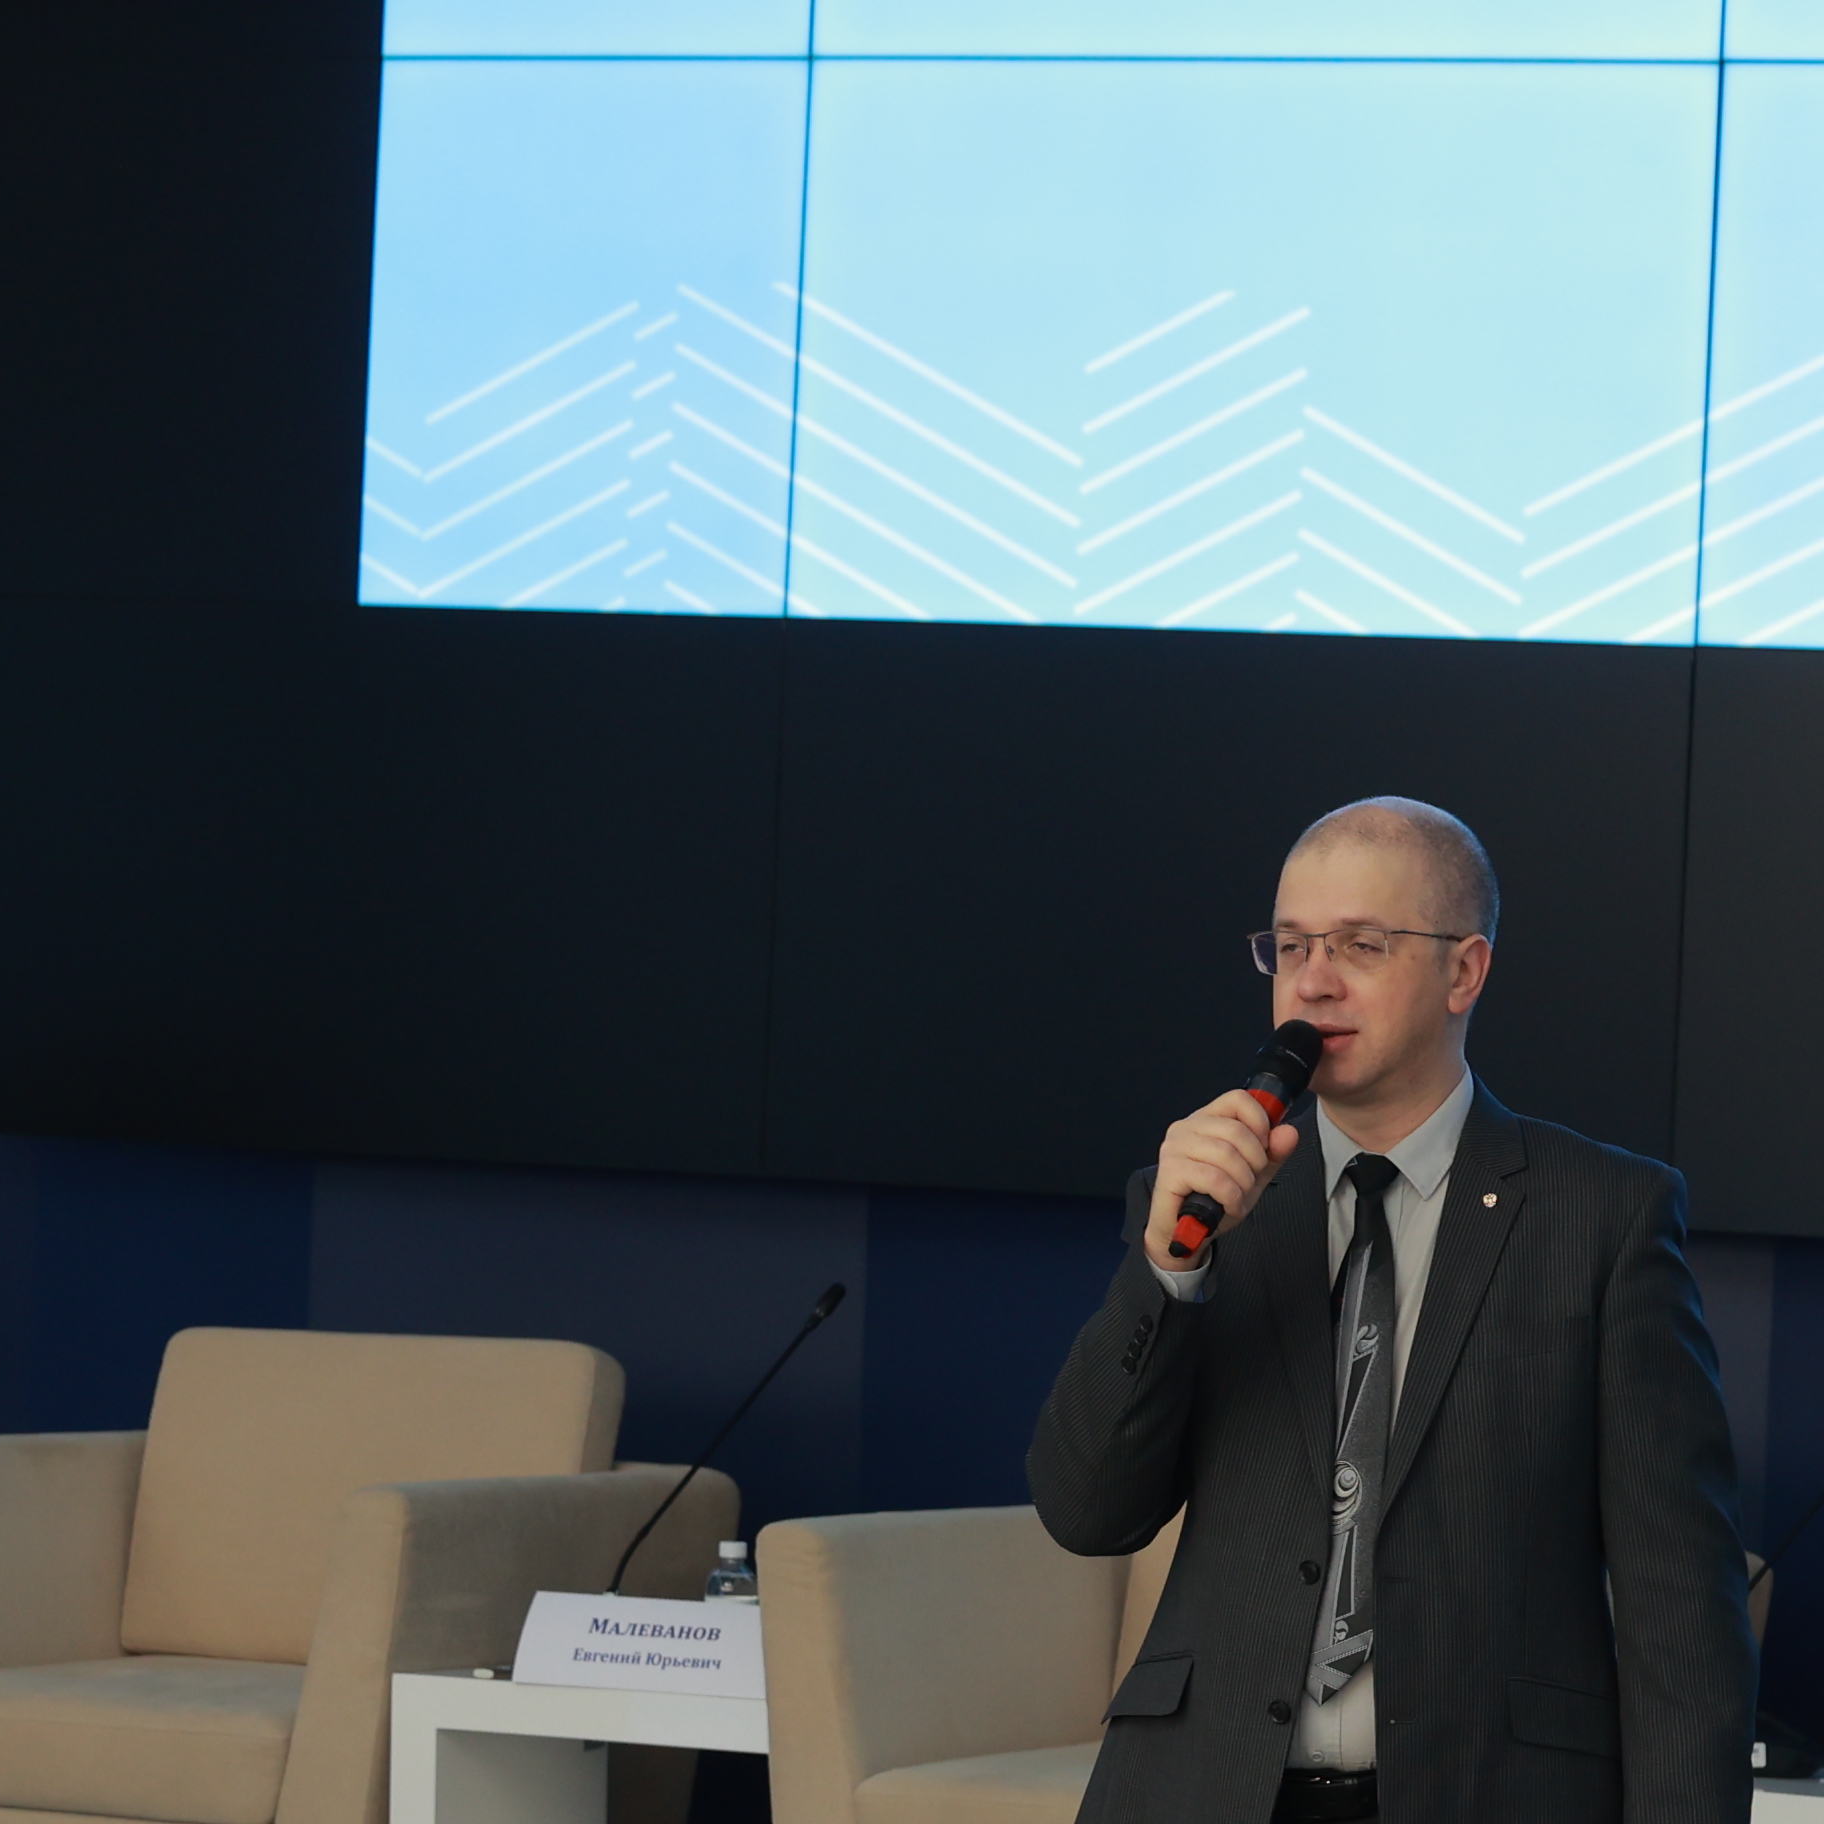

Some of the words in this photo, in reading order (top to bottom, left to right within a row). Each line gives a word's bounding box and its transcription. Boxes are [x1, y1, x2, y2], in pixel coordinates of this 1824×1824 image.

[588, 1617, 722, 1642] МАЛЕВАНОВ
[572, 1647, 642, 1666] Евгений
[645, 1652, 723, 1671] Юрьевич
